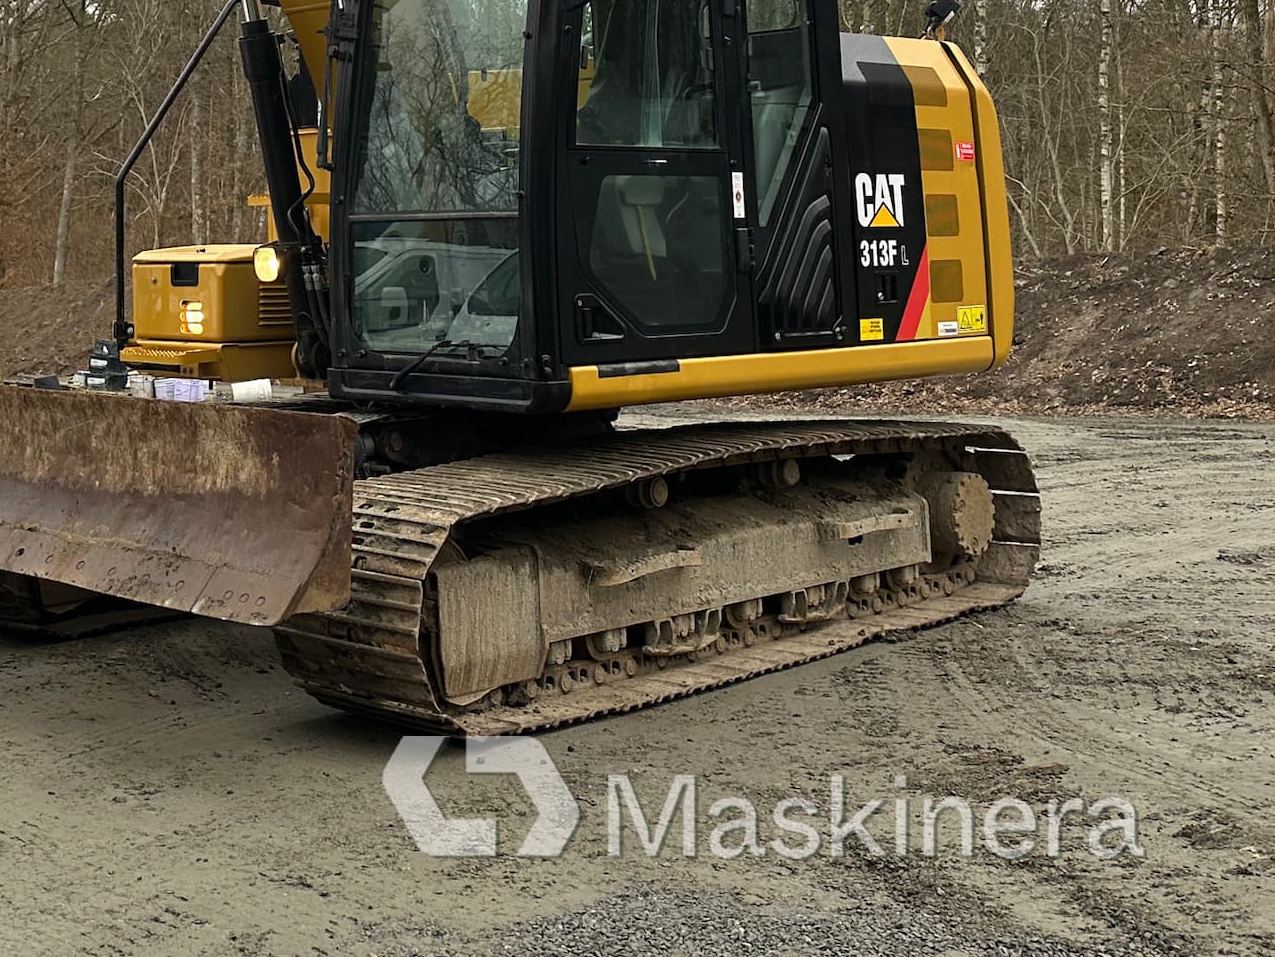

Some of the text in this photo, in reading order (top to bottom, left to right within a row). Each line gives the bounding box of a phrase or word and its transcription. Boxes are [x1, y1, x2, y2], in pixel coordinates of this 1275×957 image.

[855, 173, 905, 227] CAT
[860, 240, 909, 267] 313F L
